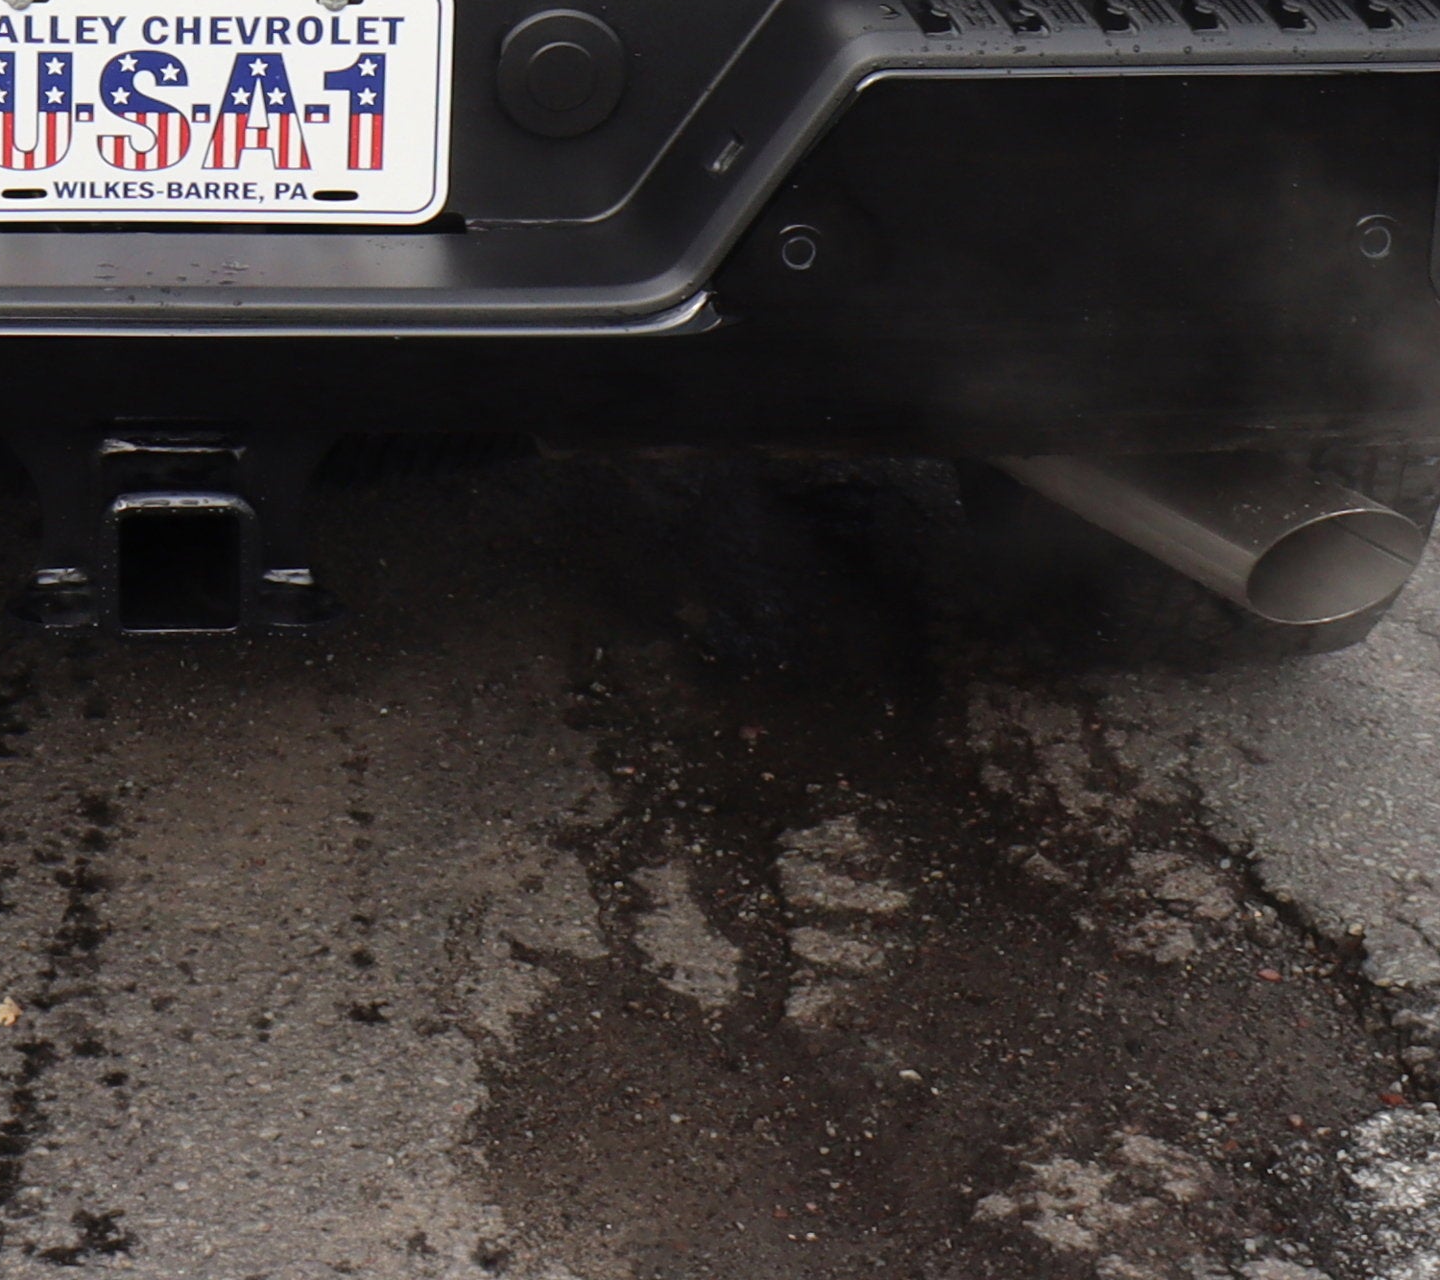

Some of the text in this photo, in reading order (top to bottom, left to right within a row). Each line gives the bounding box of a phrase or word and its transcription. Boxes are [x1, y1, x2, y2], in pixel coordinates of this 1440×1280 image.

[141, 16, 406, 46] CHEVROLET
[53, 180, 308, 203] WILKES-BARRE, PA
